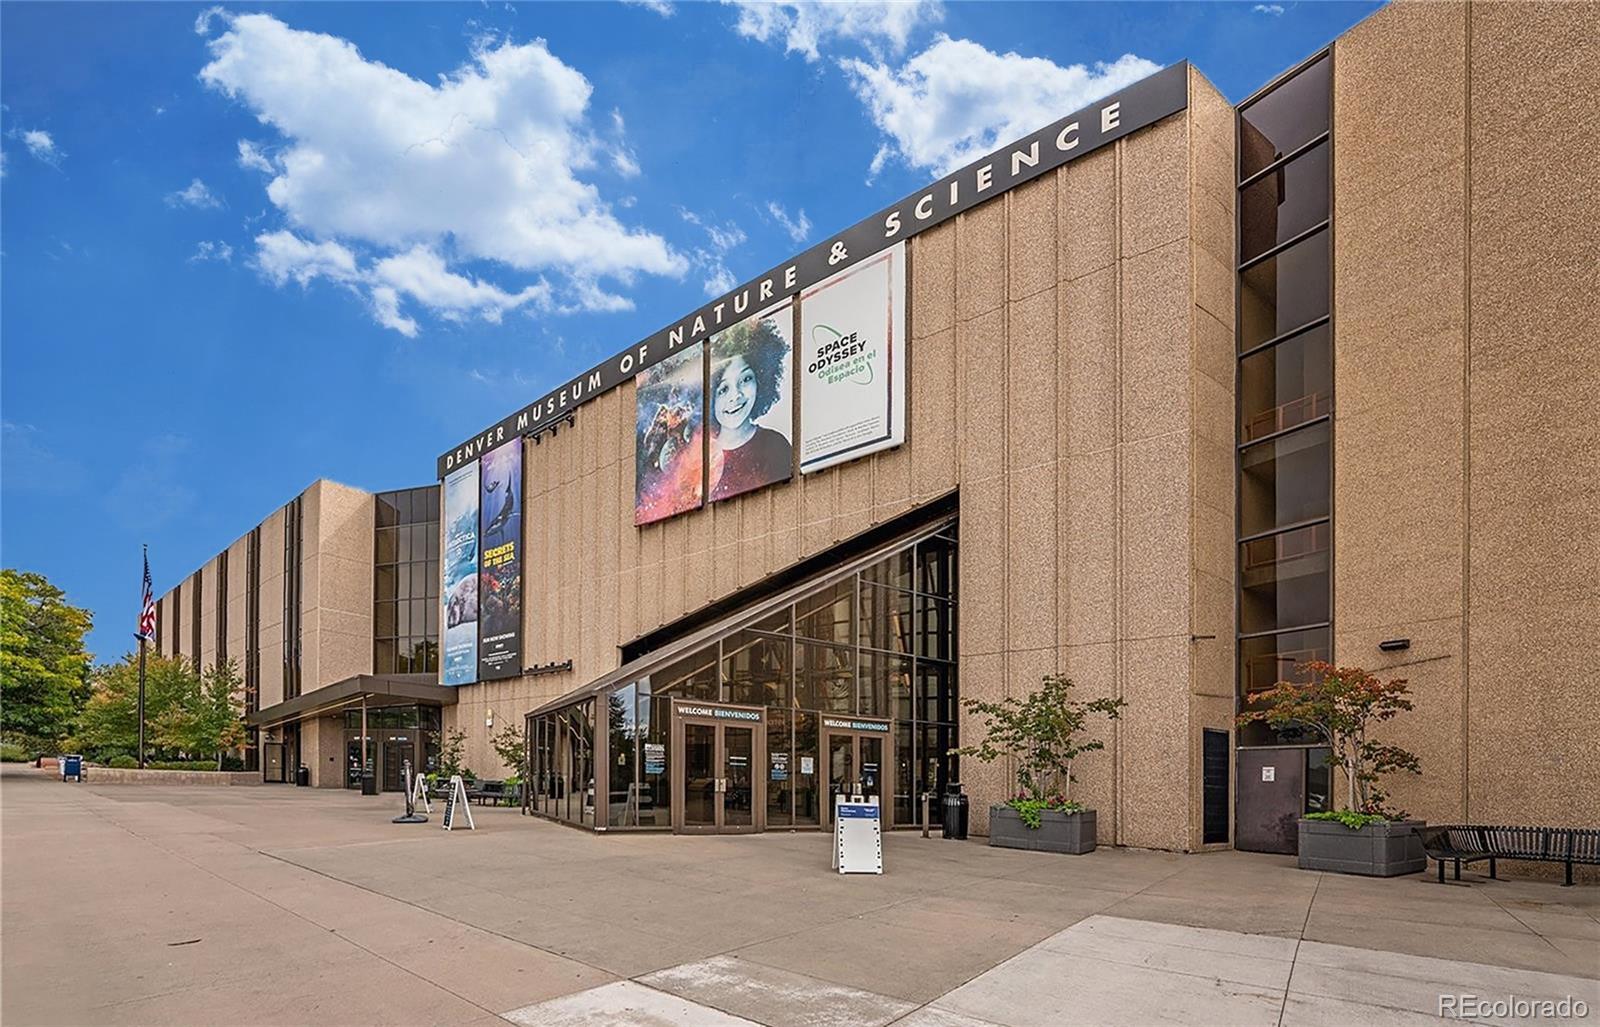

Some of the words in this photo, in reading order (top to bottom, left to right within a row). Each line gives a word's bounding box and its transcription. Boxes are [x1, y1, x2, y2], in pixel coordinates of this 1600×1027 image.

[446, 426, 504, 470] DENVER
[517, 372, 602, 430] MUSEUM
[619, 344, 648, 375] OF
[668, 265, 798, 349] NATURE
[828, 240, 849, 266] &
[885, 101, 1121, 239] SCIENCE
[808, 340, 867, 374] ODYSSEY
[817, 332, 858, 359] SPACE
[818, 361, 851, 380] Odisea
[852, 355, 865, 366] en
[867, 349, 877, 361] el
[827, 364, 865, 385] Espacio
[484, 541, 515, 560] SECRETS
[677, 706, 713, 717] WELCOME
[714, 709, 760, 721] BIENVENIDOS
[823, 719, 852, 728] WELCOME
[852, 722, 889, 732] BIENVENIDOS
